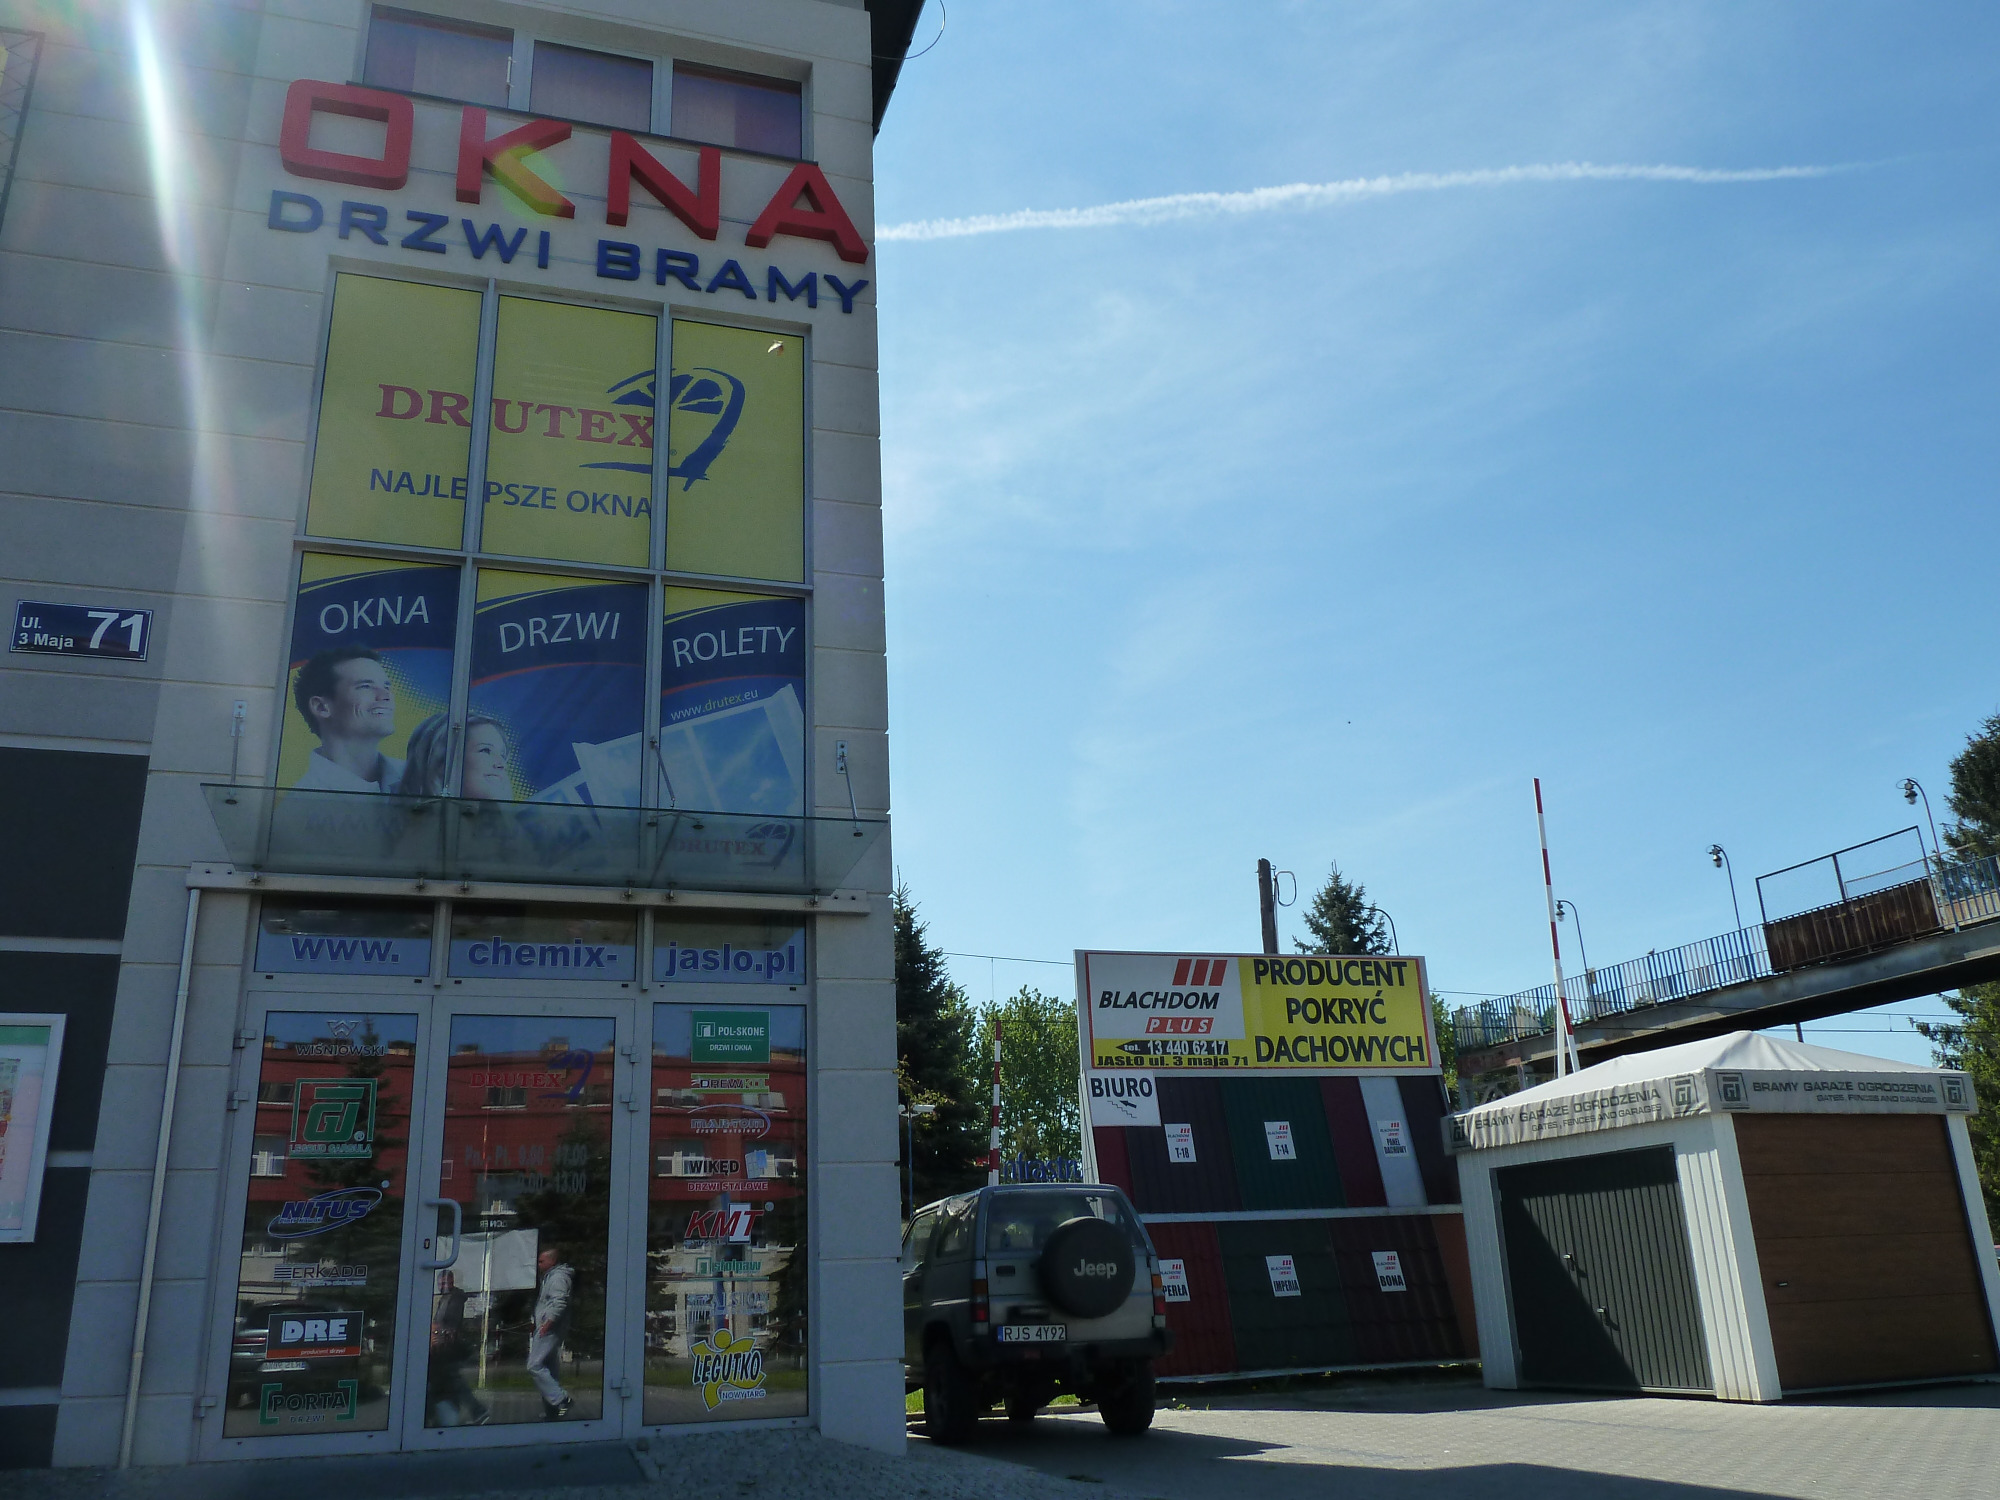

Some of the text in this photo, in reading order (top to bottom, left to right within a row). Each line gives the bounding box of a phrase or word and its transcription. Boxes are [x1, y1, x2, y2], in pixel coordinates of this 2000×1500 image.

[280, 79, 869, 264] OKNA
[268, 190, 869, 314] DRZWI BRAMY
[375, 383, 654, 449] DRUTEX
[566, 490, 652, 518] OKNA
[319, 595, 430, 634] OKNA
[18, 632, 74, 650] 3 Maja
[87, 610, 144, 652] 71
[499, 612, 620, 653] DRZWI
[672, 626, 796, 667] ROLETY
[671, 688, 759, 721] www.drutex.eu
[292, 936, 400, 963] www.
[467, 936, 618, 969] chemix-
[666, 941, 796, 980] jaslo.pl
[1254, 959, 1407, 987] PRODUCENT
[1099, 991, 1219, 1009] BLACHDOM
[1286, 990, 1386, 1025] POKRYĆ
[718, 1026, 765, 1037] POL-SKONE
[1149, 1018, 1209, 1033] PLUS
[296, 1042, 386, 1056] WIŚNIOWSKI
[709, 1044, 730, 1052] DRZWI
[734, 1044, 752, 1052] OKNA
[1124, 1040, 1226, 1055] tel. 13 440 62 17
[1255, 1036, 1425, 1063] DACHOWYCH
[1097, 1055, 1248, 1067] JASŁO ul. 3 maja 71
[470, 1072, 563, 1088] DRUTEX
[1091, 1077, 1153, 1098] BIURO
[1753, 1081, 1798, 1092] BRAMY
[1858, 1082, 1935, 1094] OGRODZENIA
[1475, 1114, 1514, 1130] BRAMY
[1573, 1088, 1661, 1114] OGRODZENIA
[1563, 1115, 1596, 1128] FENCES
[1598, 1110, 1617, 1122] AND
[1618, 1103, 1662, 1118] GARAGES
[689, 1159, 740, 1176] WIKĘD
[688, 1181, 768, 1192] DRZWI STALOWE
[280, 1200, 370, 1218] NITUS
[685, 1210, 764, 1238] KMT
[291, 1263, 367, 1279] ERKADO
[1073, 1258, 1117, 1279] Jeep
[1379, 1274, 1404, 1287] BONA
[281, 1318, 348, 1343] DRE
[1004, 1326, 1065, 1340] RJS 4Y92
[693, 1350, 762, 1384] LEGUTKO
[271, 1391, 347, 1413] PORTA
[722, 1389, 766, 1400] NOWY TARG
[290, 1415, 326, 1424] DRZWI
